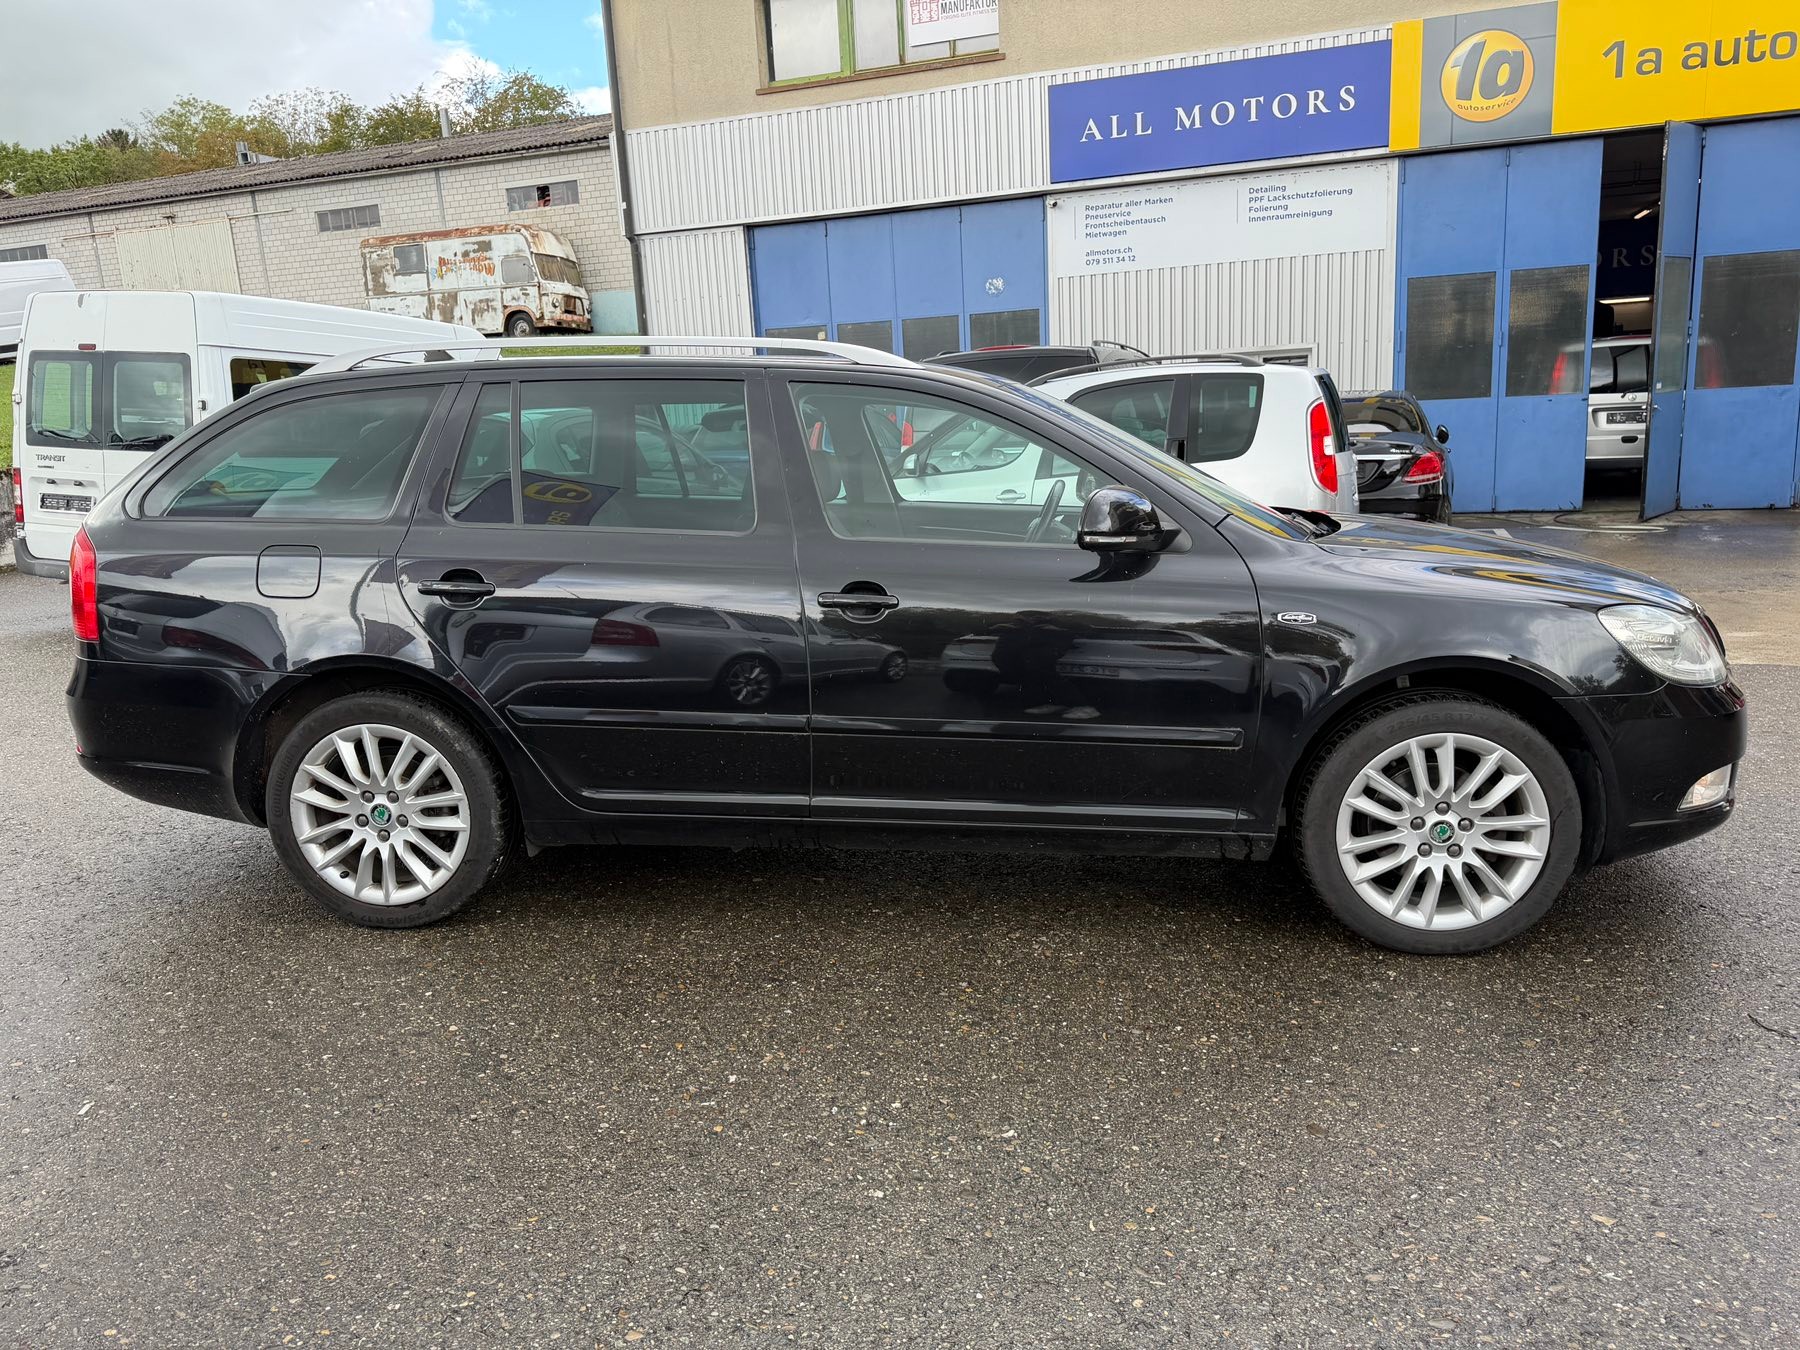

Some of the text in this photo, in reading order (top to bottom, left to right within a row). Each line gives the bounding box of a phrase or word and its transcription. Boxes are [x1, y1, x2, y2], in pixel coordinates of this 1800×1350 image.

[1602, 29, 1798, 79] 1a auto
[1451, 39, 1524, 100] 1a
[1457, 97, 1517, 112] autoservice
[1080, 85, 1356, 142] ALL MOTORS
[1248, 185, 1287, 194] Detailing
[1248, 188, 1353, 204] PPF Lackschutzfolierung
[1085, 197, 1173, 212] Reparatur aller Marken
[1248, 203, 1289, 213] Folierung
[1085, 211, 1132, 221] Pneuservice
[1085, 216, 1166, 230] Frontscheibentausch
[1248, 209, 1333, 223] Innenraumreinigung
[1085, 229, 1127, 239] Mietwagen
[1085, 246, 1133, 257] allmotors.ch
[1085, 258, 1100, 266] 079
[36, 454, 66, 462] TRANSIT
